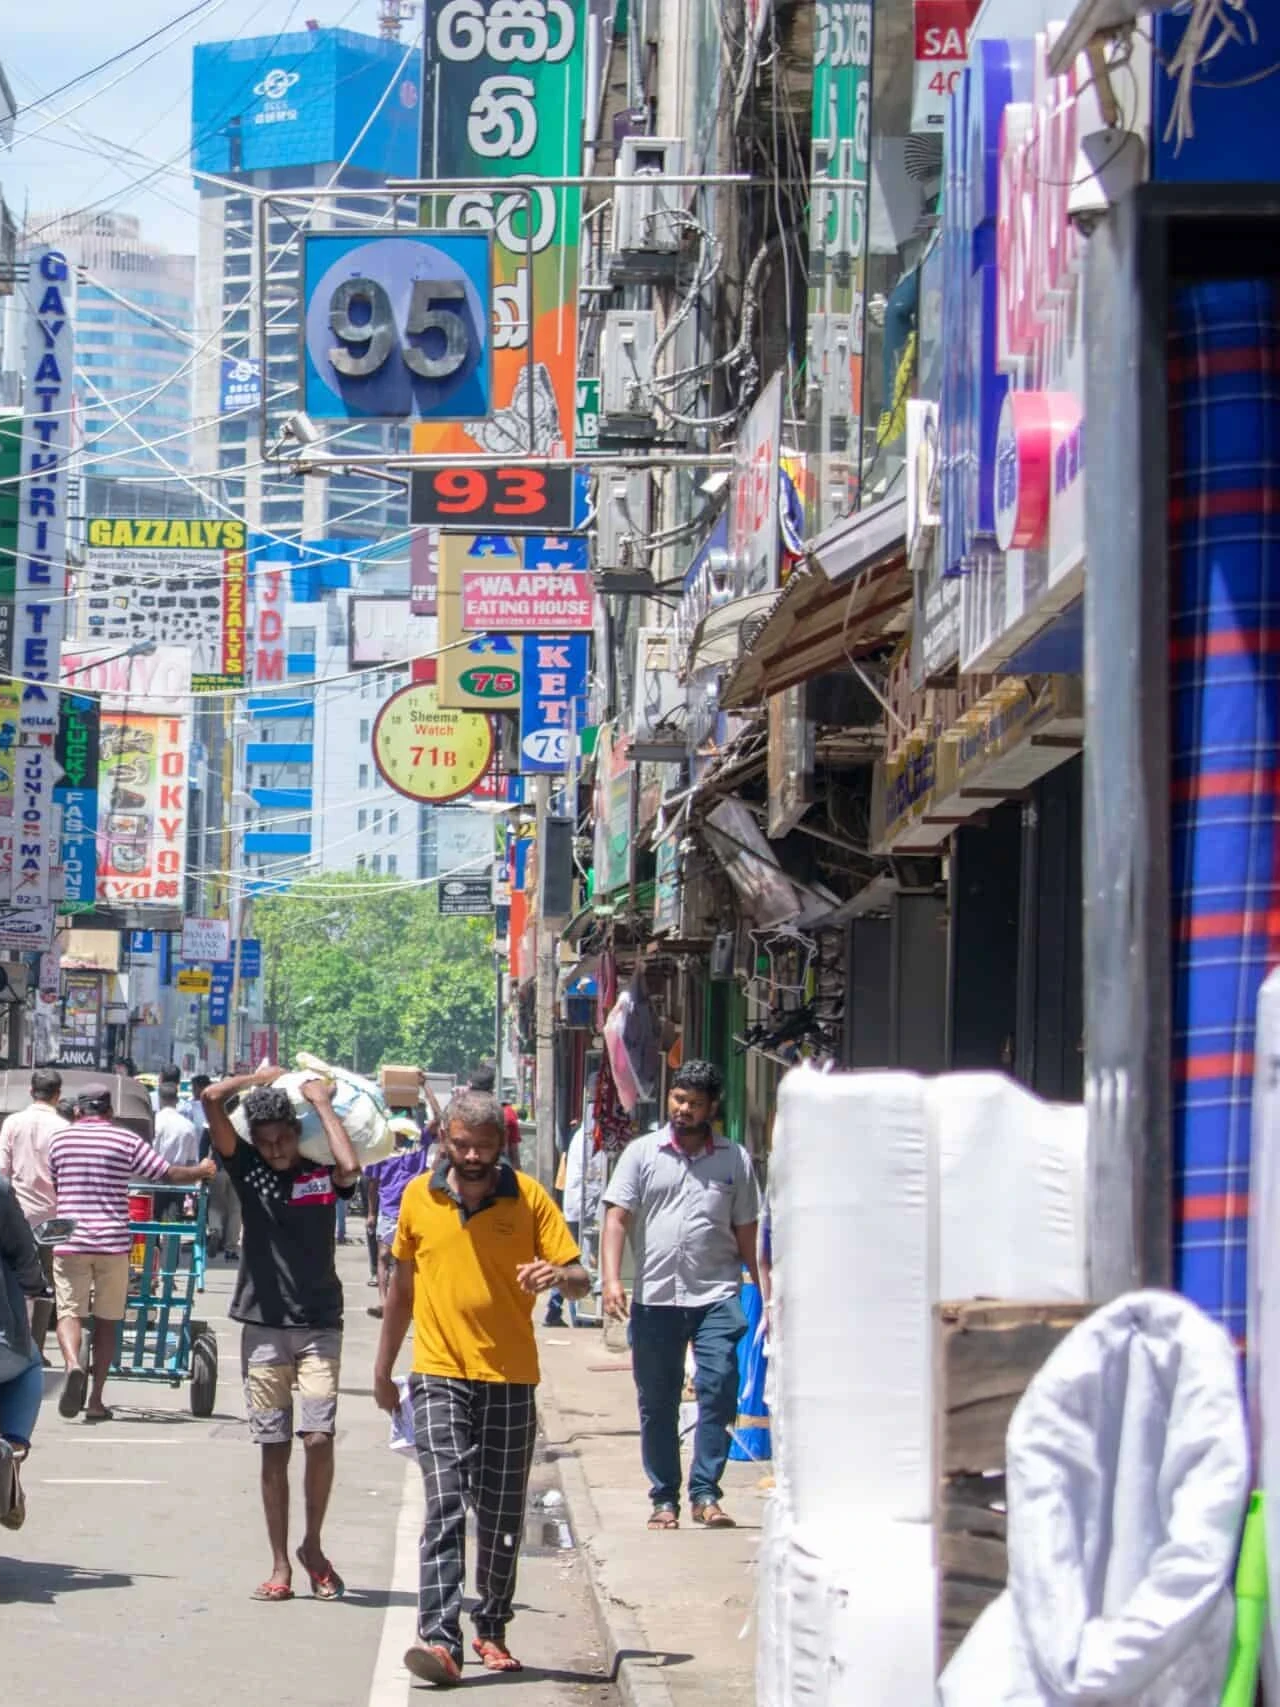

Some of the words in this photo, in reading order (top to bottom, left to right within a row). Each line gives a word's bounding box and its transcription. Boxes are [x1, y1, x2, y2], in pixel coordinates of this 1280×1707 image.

[328, 276, 469, 379] 95
[433, 466, 547, 515] 93
[89, 520, 245, 549] GAZZALYS
[226, 552, 243, 674] GAZZALYS
[257, 570, 284, 681] JDM
[466, 600, 530, 615] EATING
[533, 600, 590, 615] HOUSE
[22, 604, 51, 702] TEX
[469, 672, 514, 691] 75
[409, 710, 459, 723] Sheema
[414, 724, 455, 737] Watch
[157, 719, 184, 873] TOKYO
[63, 791, 83, 900] FASHIONS
